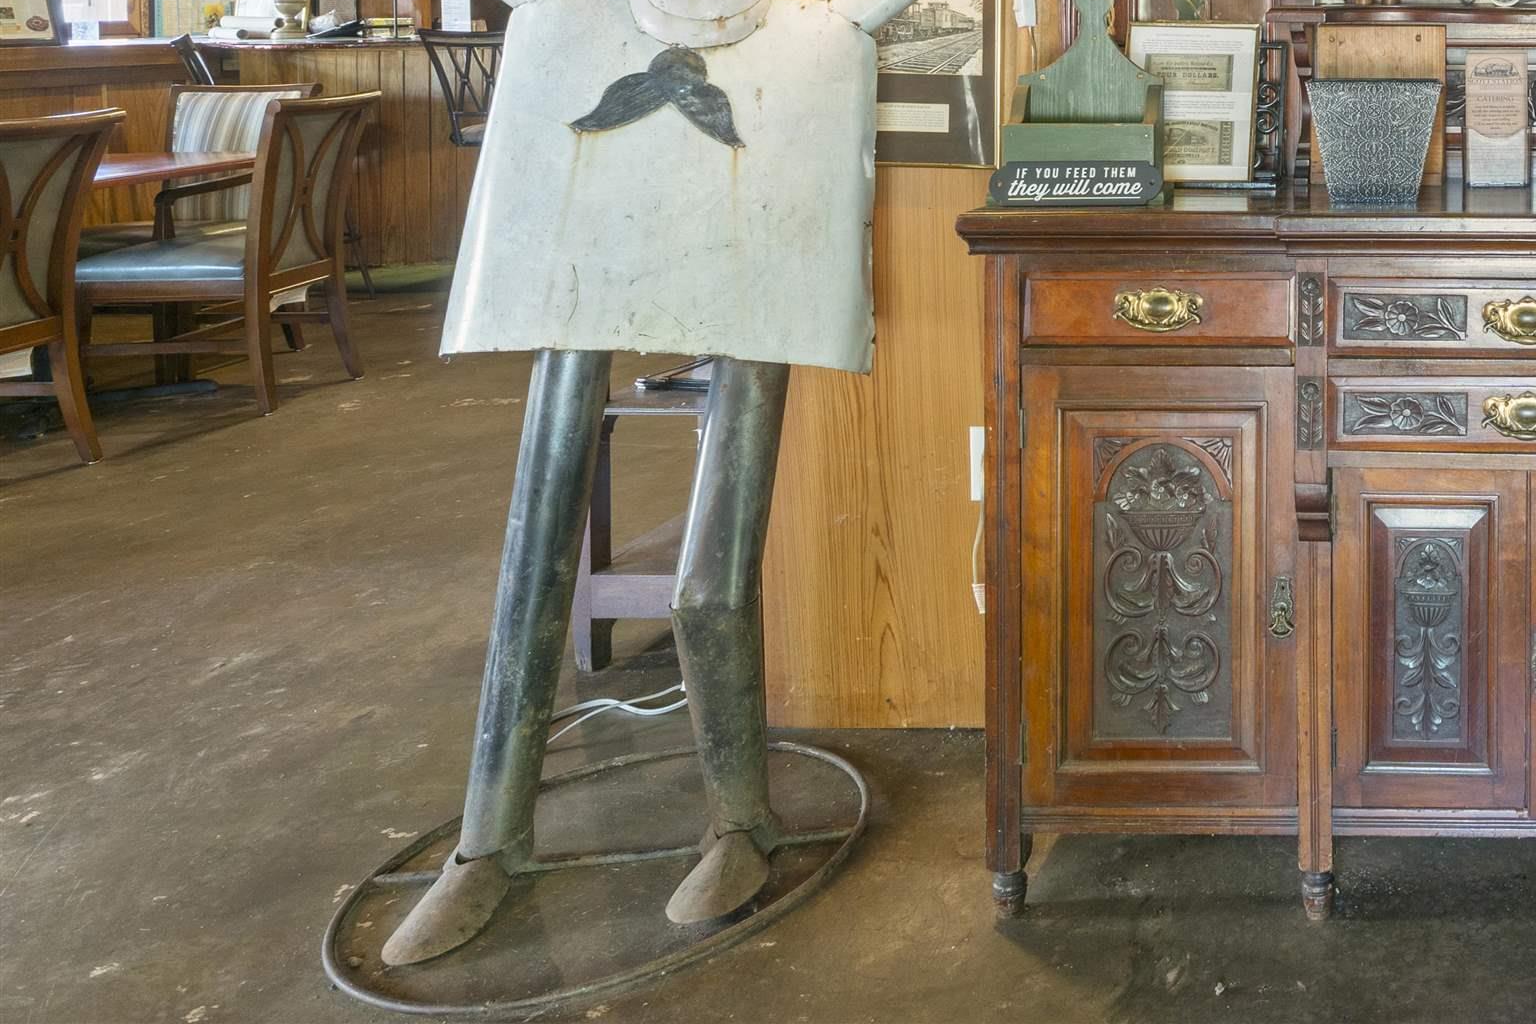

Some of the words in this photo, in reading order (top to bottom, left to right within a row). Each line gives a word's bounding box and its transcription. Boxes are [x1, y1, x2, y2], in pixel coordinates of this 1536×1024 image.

[1016, 167, 1029, 179] IF
[1036, 167, 1060, 179] YOU
[1065, 167, 1097, 179] FEED
[1103, 167, 1137, 178] THEM
[1007, 180, 1051, 202] they
[1051, 179, 1091, 196] will
[1092, 181, 1144, 196] come
